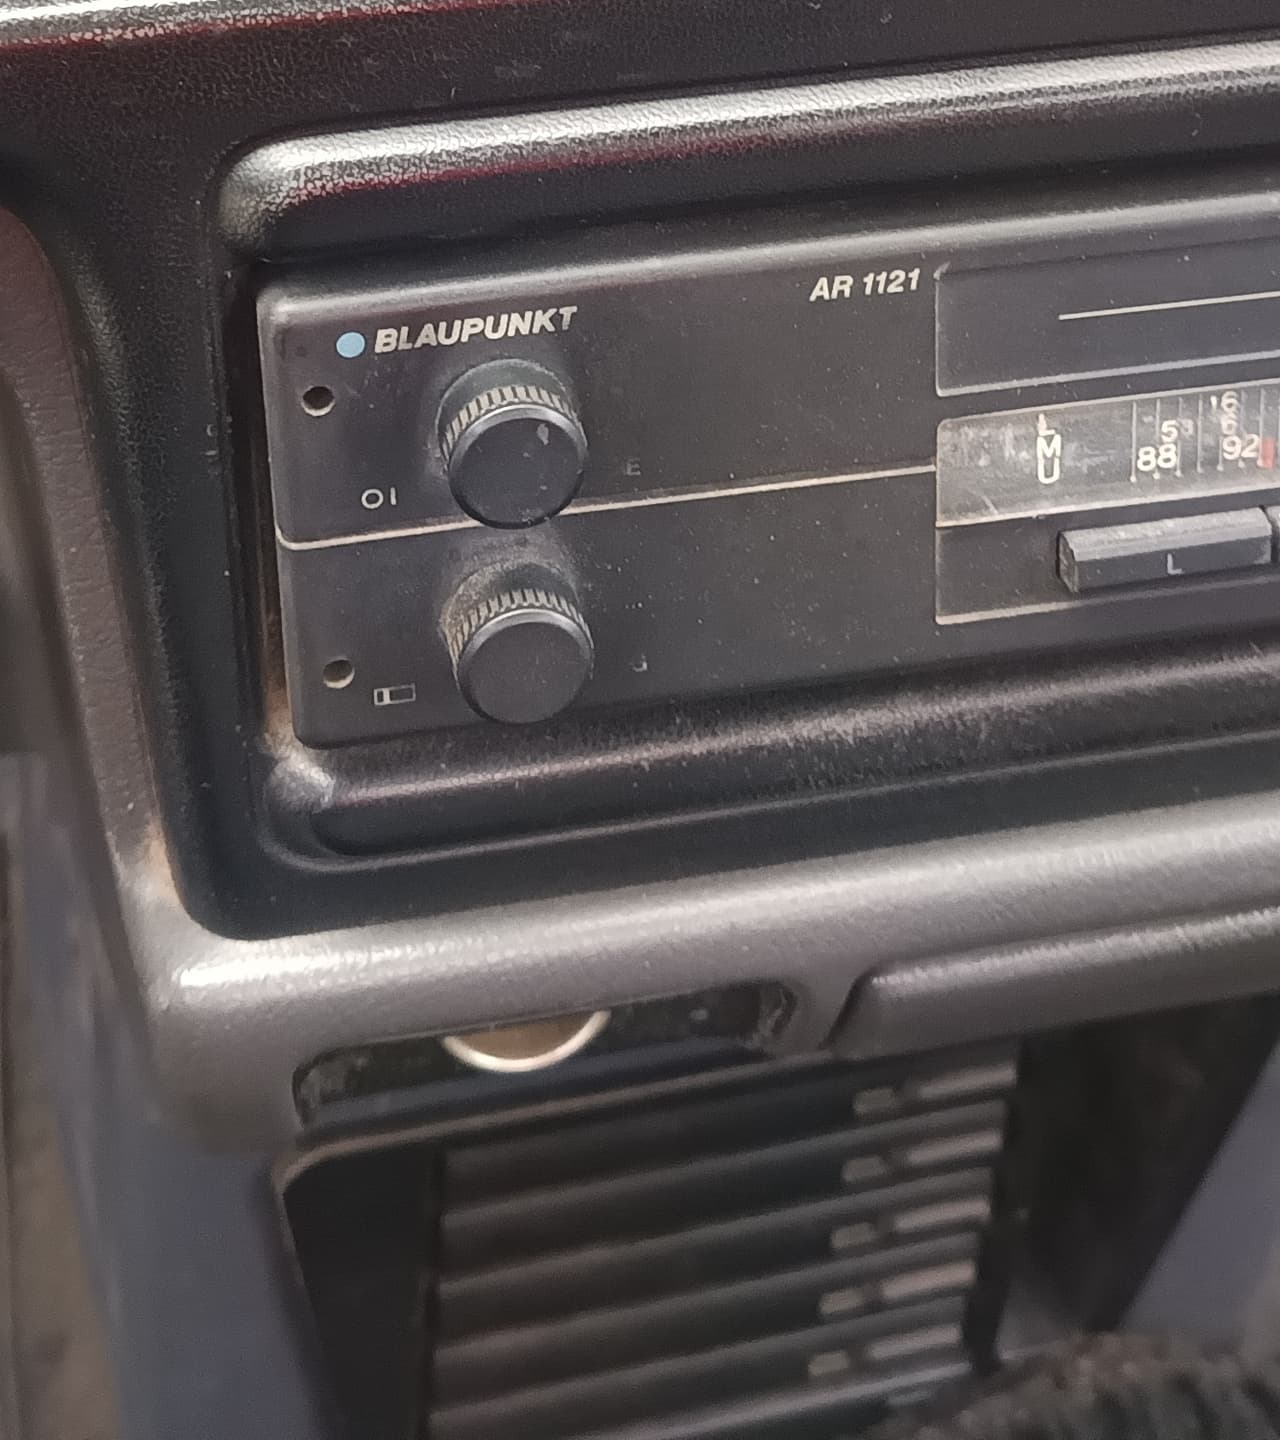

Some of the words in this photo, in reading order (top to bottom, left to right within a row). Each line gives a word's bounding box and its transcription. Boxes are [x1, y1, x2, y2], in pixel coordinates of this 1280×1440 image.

[809, 274, 854, 302] AR
[863, 267, 920, 295] 1121
[374, 306, 578, 354] BLAUPUNKT
[1136, 442, 1177, 472] 88
[1222, 433, 1261, 460] 92
[1166, 553, 1183, 576] L
